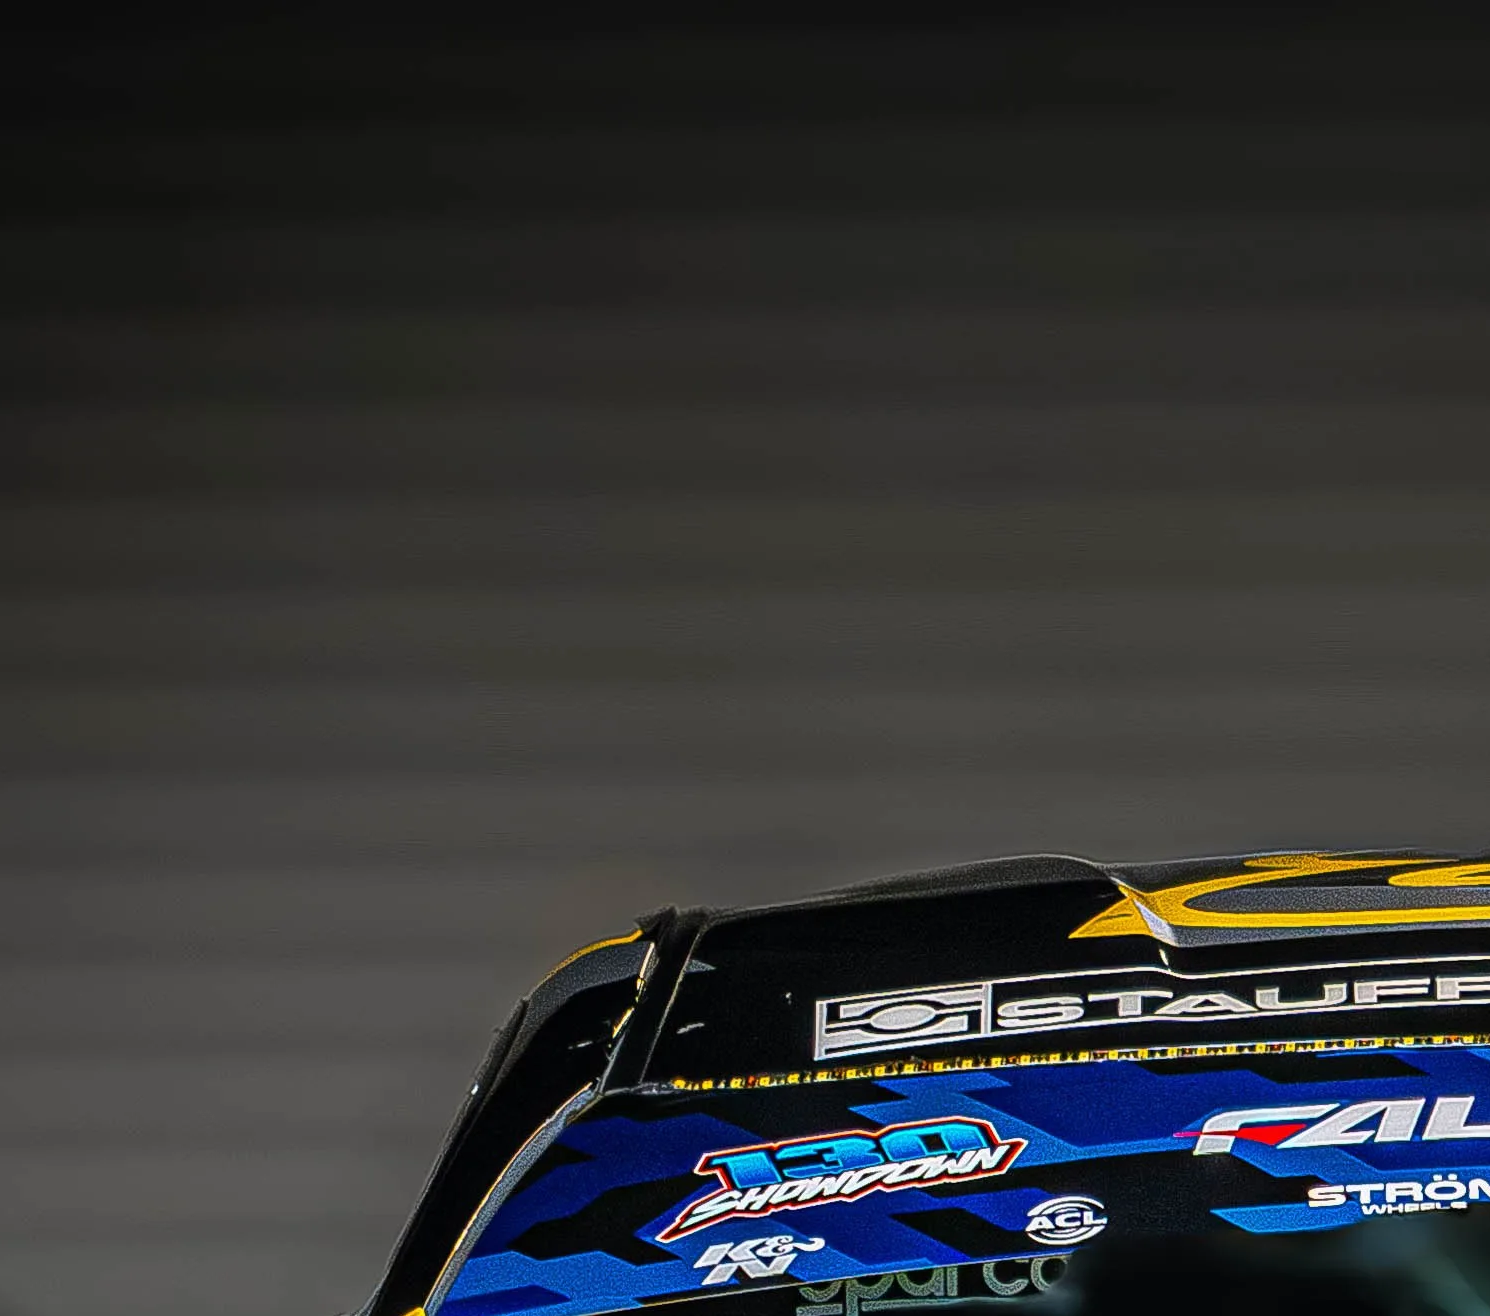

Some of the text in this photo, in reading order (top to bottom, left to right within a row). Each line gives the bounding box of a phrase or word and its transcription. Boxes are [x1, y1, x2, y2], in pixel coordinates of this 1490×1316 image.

[680, 1145, 1010, 1229] SHOWDOWN
[712, 1122, 989, 1189] 130
[1025, 1208, 1108, 1234] ACL
